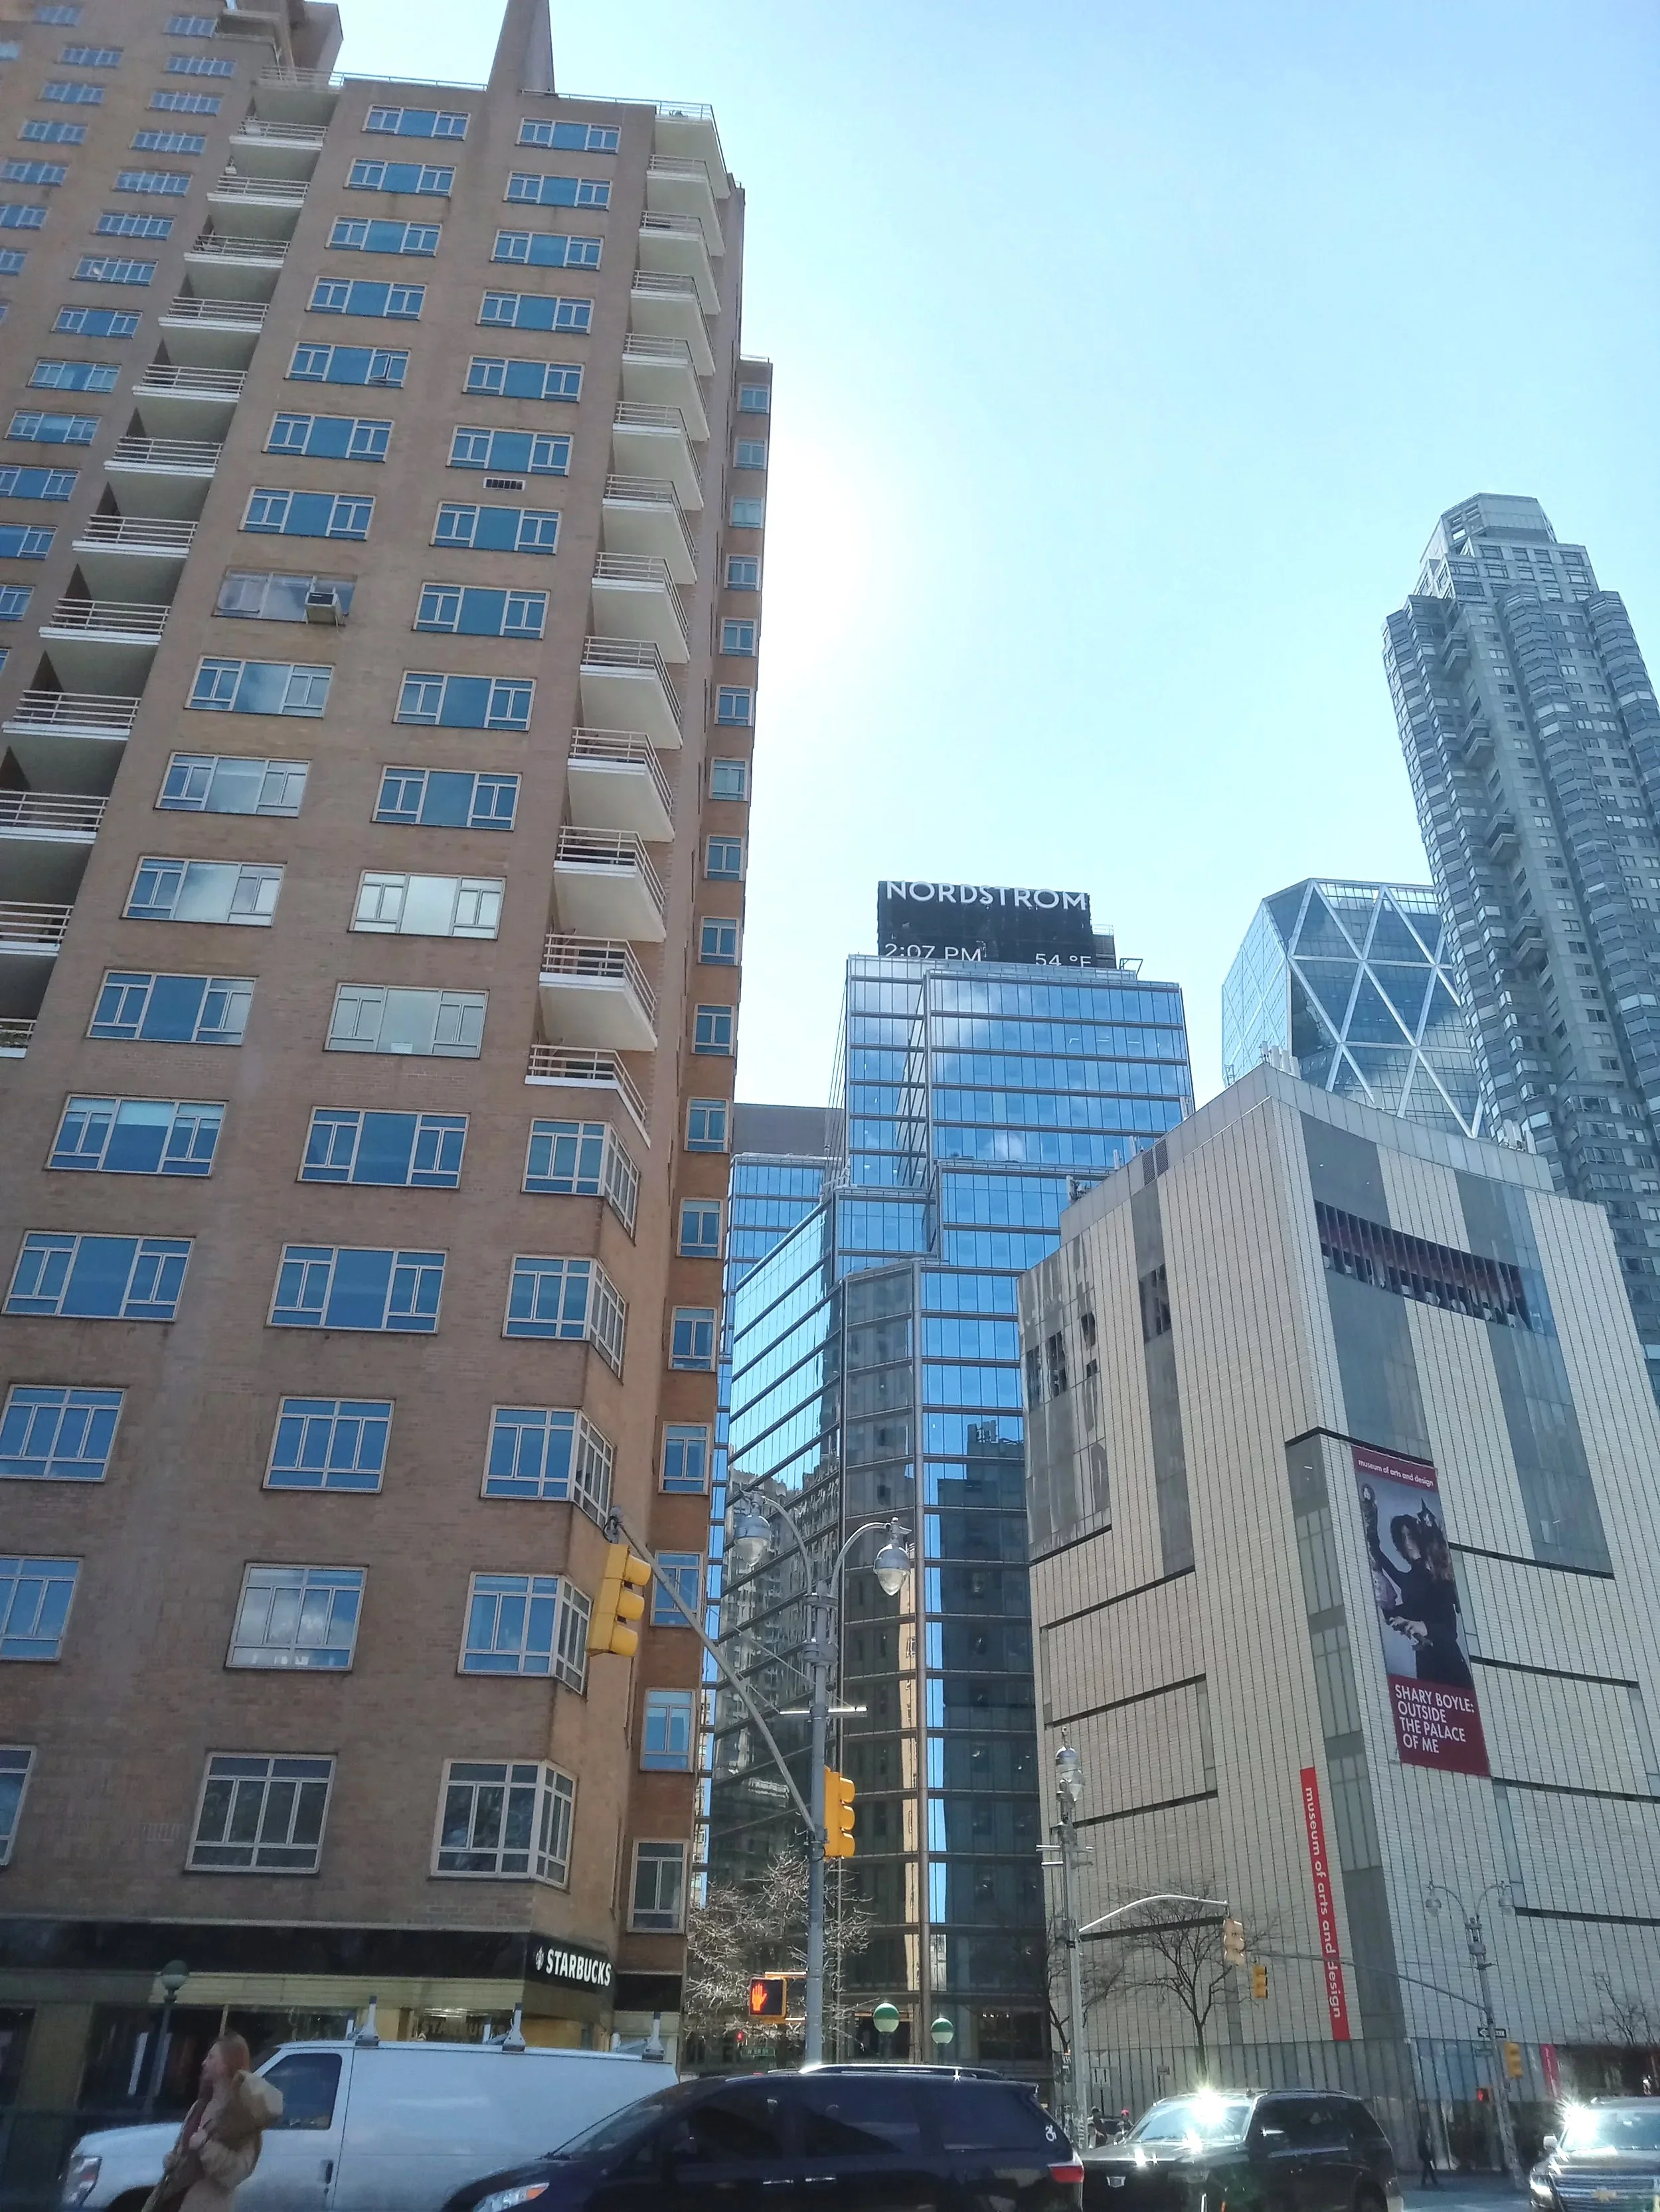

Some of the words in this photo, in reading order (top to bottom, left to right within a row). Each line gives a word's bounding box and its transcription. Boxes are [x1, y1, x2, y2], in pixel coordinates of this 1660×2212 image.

[886, 880, 1087, 911] NORDSTROM
[884, 943, 935, 958] 2:07
[944, 946, 981, 961] PM
[1035, 953, 1062, 966] 54
[1358, 1460, 1382, 1472] museum
[1390, 1469, 1401, 1478] arts
[1414, 1475, 1434, 1487] design
[1395, 1684, 1432, 1705] SHARY
[1435, 1692, 1474, 1713] BOYLE:
[1398, 1701, 1446, 1723] OUTSIDE
[1399, 1717, 1421, 1734] THE
[1424, 1721, 1466, 1742] PALACE
[1403, 1733, 1418, 1749] OF
[1422, 1737, 1439, 1753] ME
[1305, 1787, 1320, 1856] museum
[1315, 1861, 1326, 1878] of
[1317, 1883, 1328, 1915] arts
[1322, 1921, 1336, 1953] and
[546, 1949, 612, 1986] STARBUCKS
[1328, 1960, 1341, 2017] design
